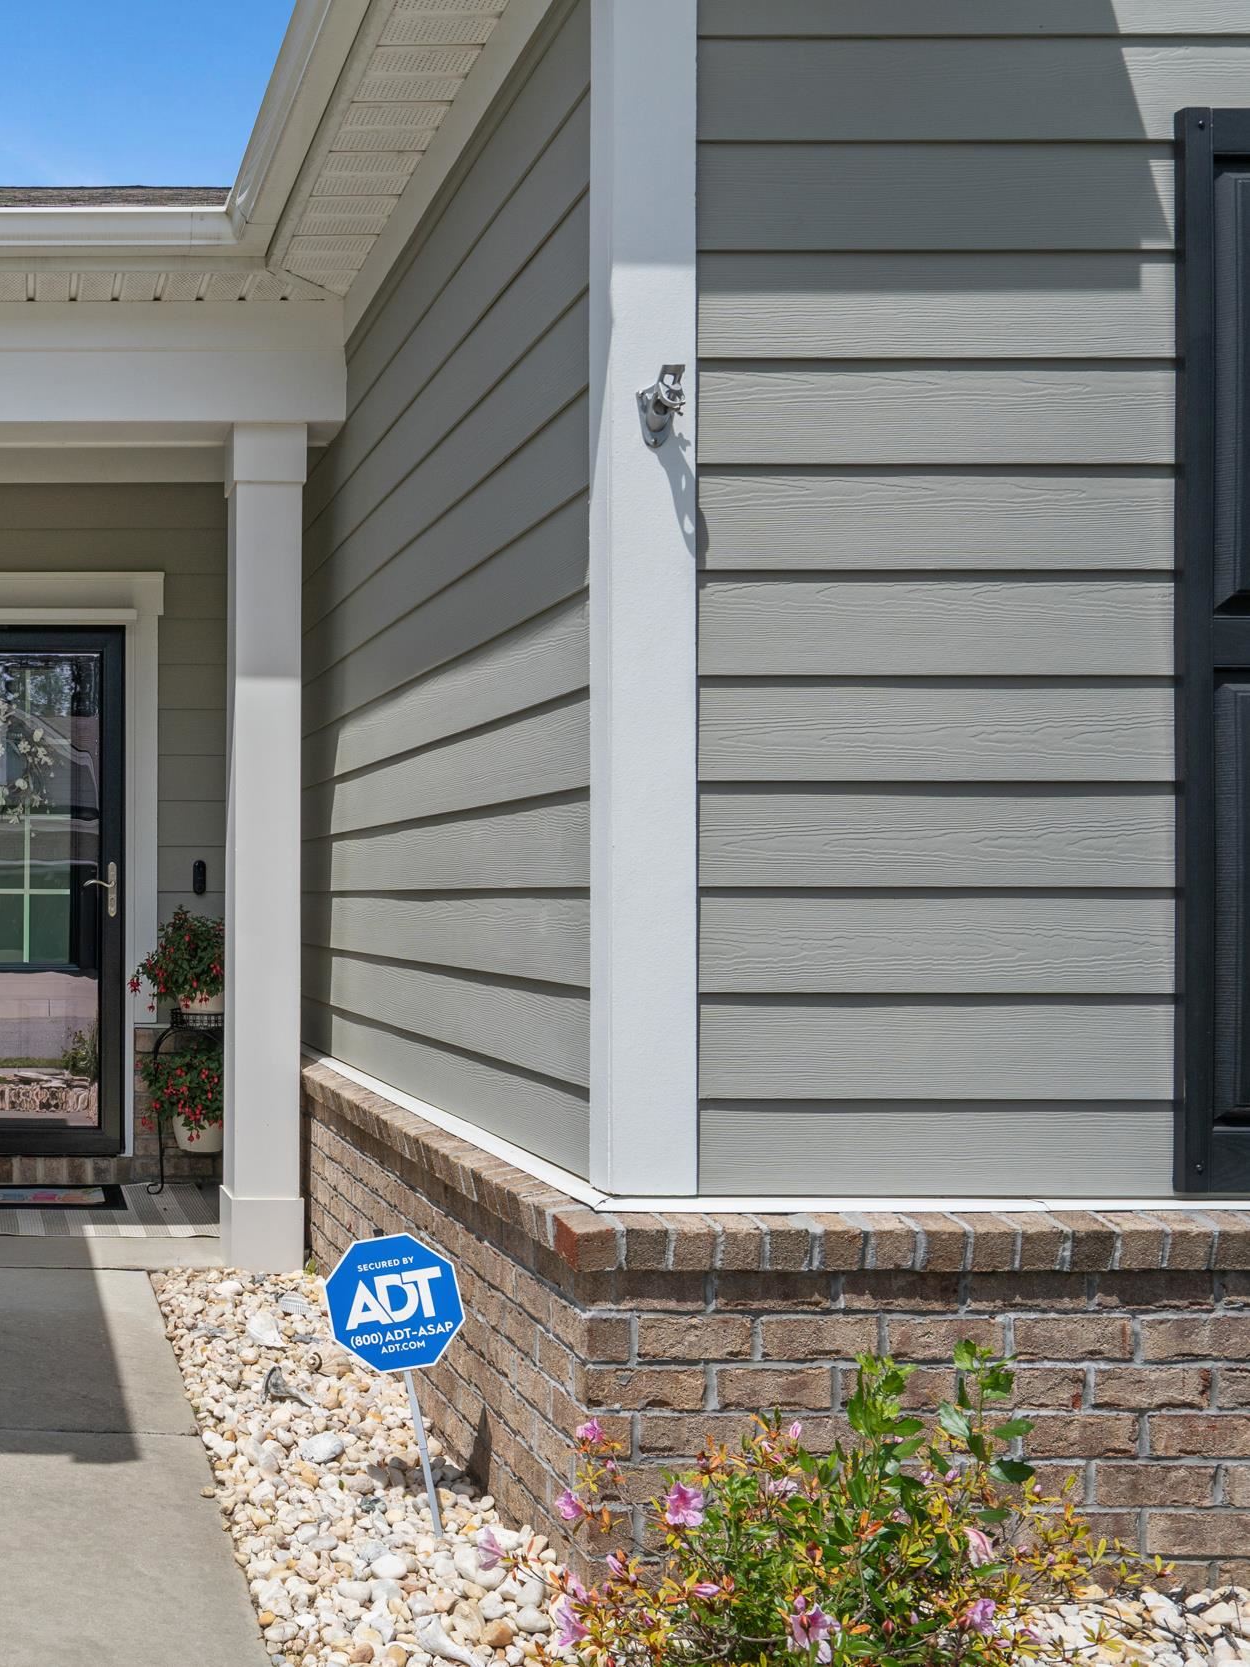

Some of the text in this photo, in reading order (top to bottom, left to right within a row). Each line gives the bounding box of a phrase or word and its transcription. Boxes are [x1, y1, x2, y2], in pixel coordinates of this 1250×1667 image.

[357, 1256, 414, 1272] SECURED BY
[345, 1266, 442, 1331] ADT
[350, 1321, 454, 1349] (800) ADT-ASAP
[381, 1340, 426, 1354] ADT.COM
